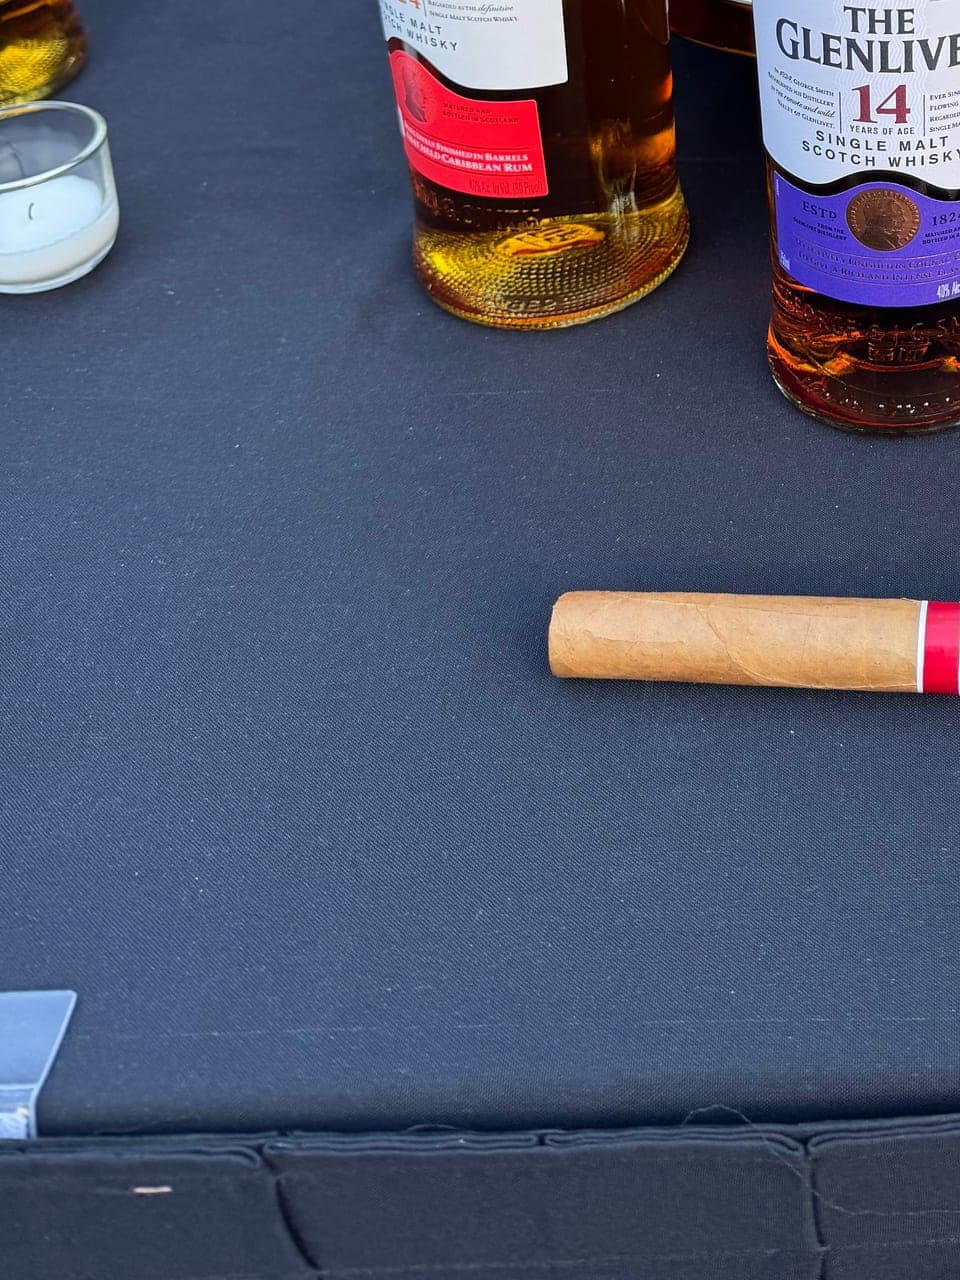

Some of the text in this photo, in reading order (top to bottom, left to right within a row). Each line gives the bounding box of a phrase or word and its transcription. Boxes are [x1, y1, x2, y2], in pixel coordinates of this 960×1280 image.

[410, 17, 442, 35] MALT
[843, 5, 915, 35] THE
[406, 27, 459, 52] WHISKY
[851, 84, 911, 125] 14
[929, 93, 947, 101] EVER
[929, 101, 959, 111] FLOWING
[850, 125, 915, 136] YEARS OF AGE
[929, 124, 951, 133] SINGLE
[815, 130, 949, 152] SINGLE MALT
[441, 153, 533, 173] CARIBBEAN RUM
[485, 152, 529, 162] BARRELS
[801, 140, 876, 167] SCOTCH
